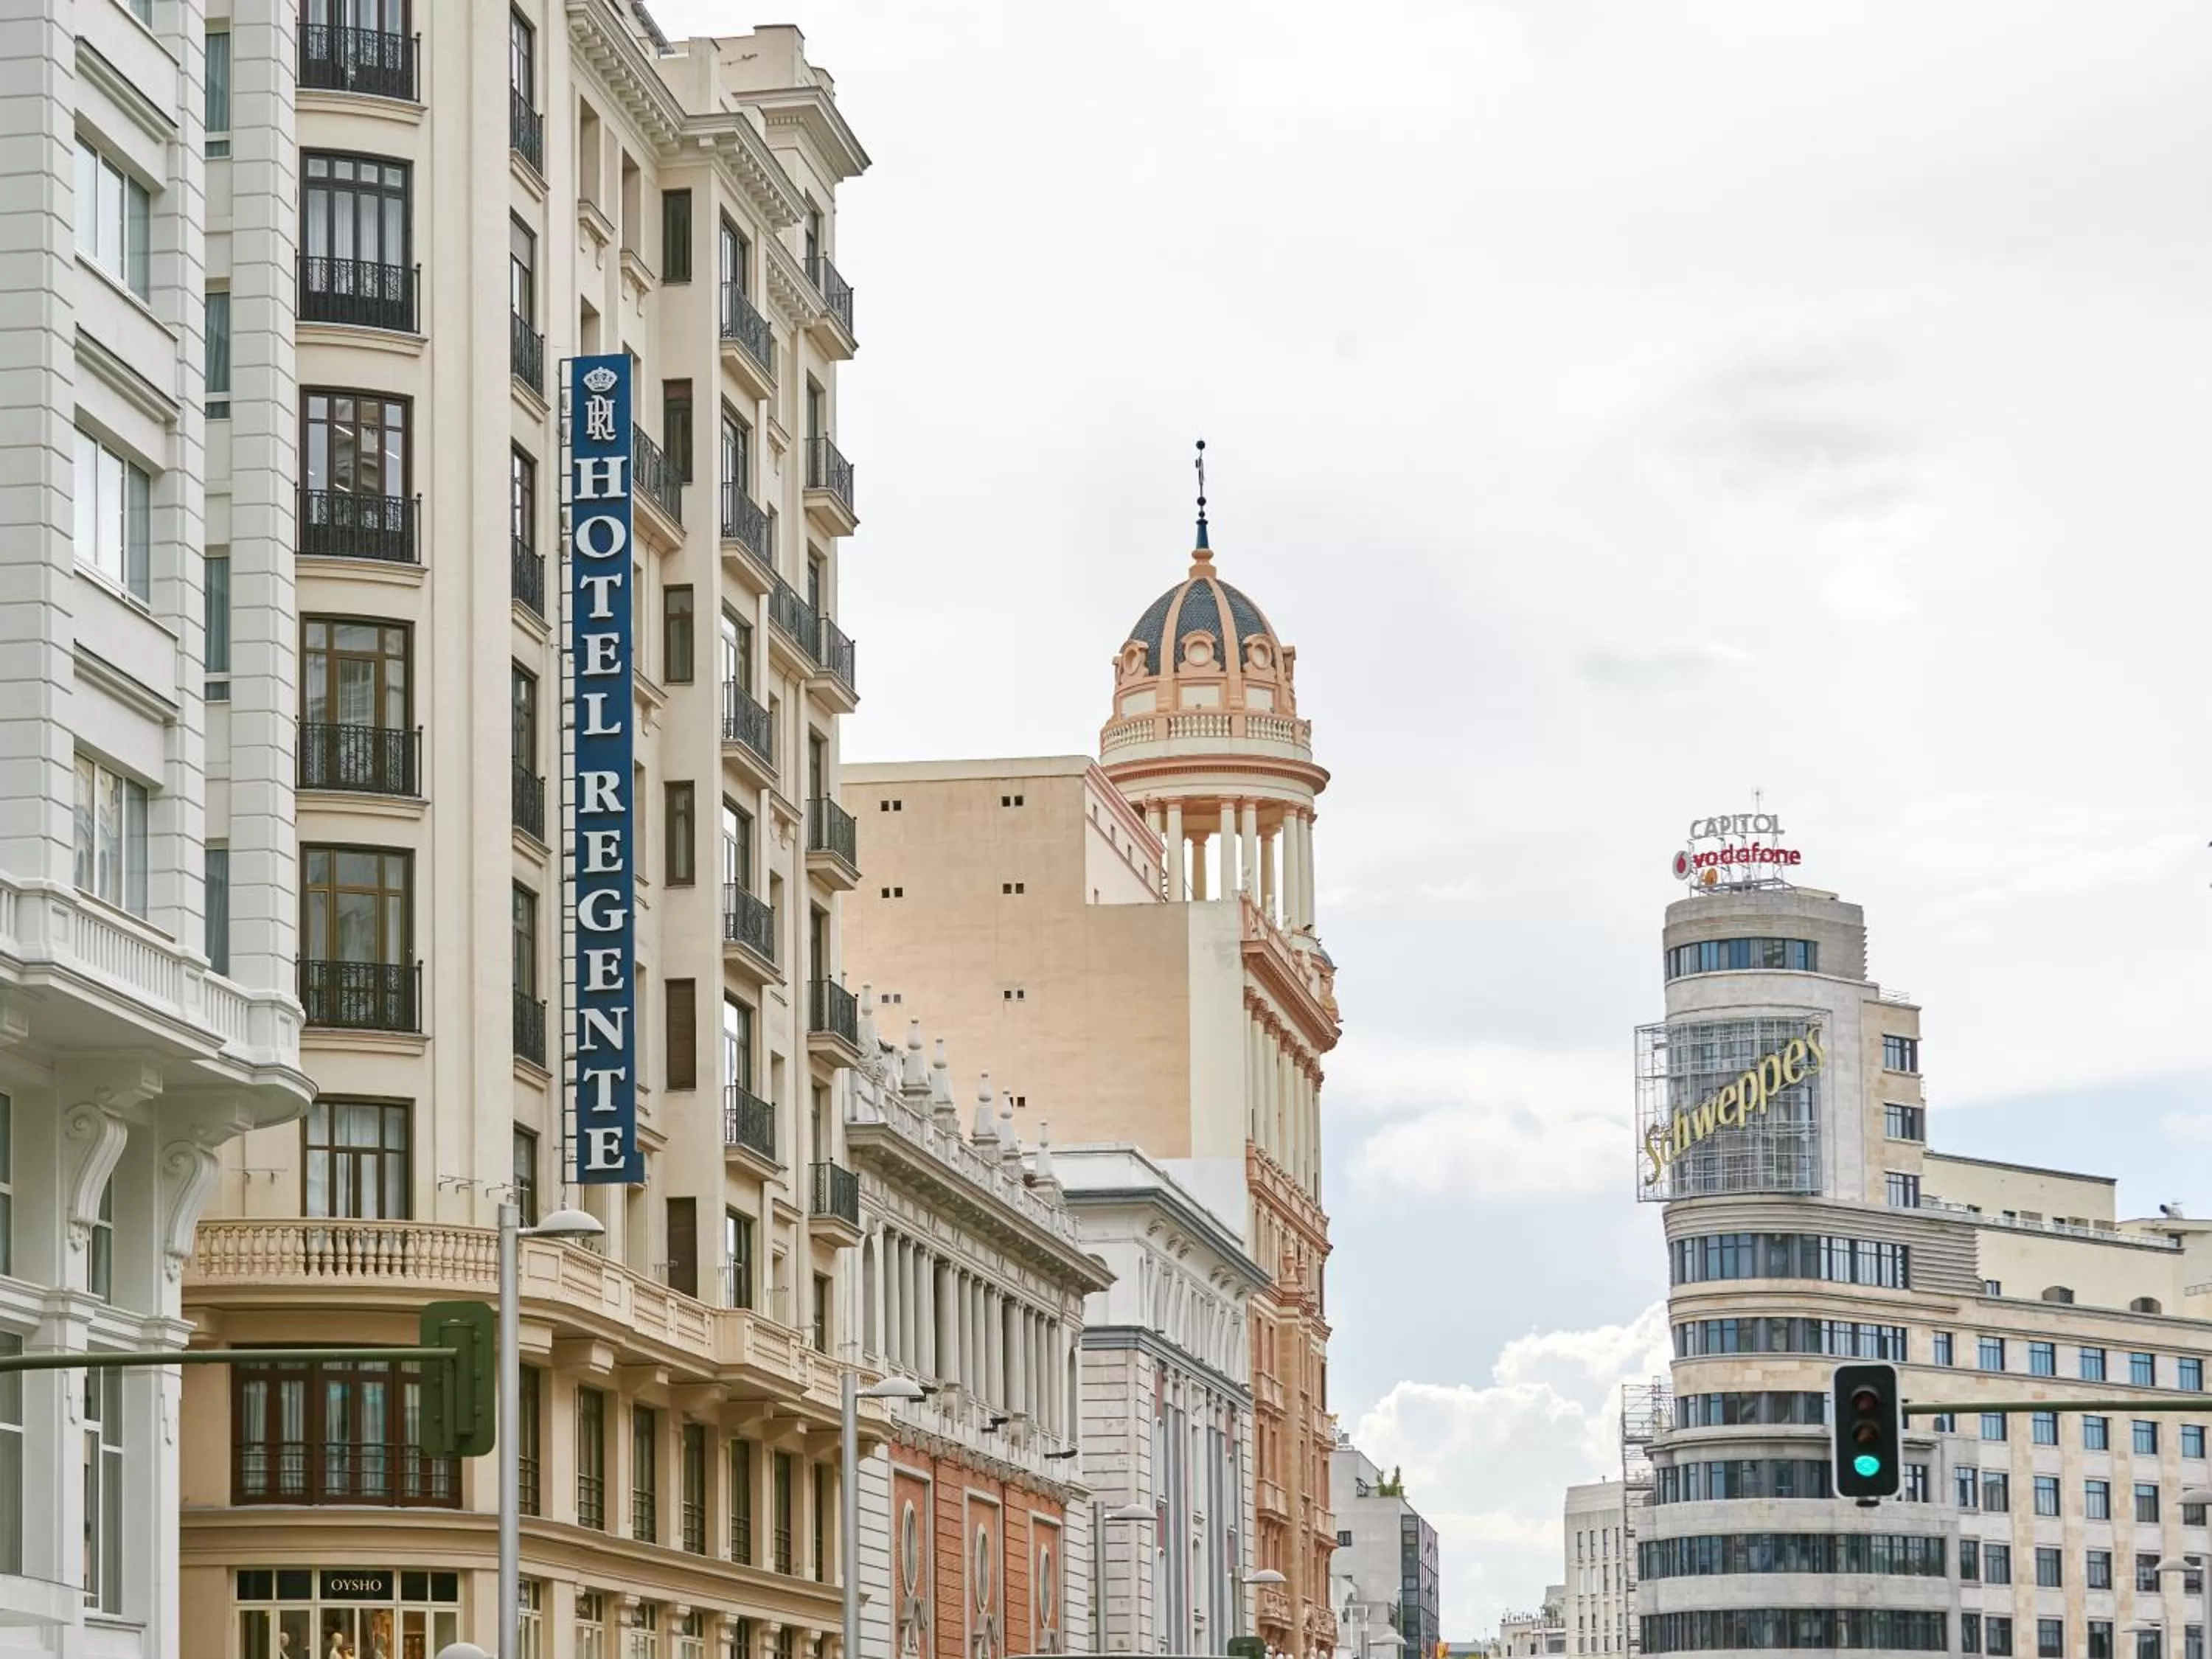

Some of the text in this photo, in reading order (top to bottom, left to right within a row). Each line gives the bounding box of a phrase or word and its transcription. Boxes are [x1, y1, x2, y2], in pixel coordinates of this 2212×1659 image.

[574, 455, 628, 1171] HOTEL REGENTE
[1690, 813, 1785, 839] CAPITOL
[1693, 842, 1801, 868] vodafone
[1645, 1026, 1825, 1186] Schweppes
[331, 1579, 382, 1591] OYSHO
